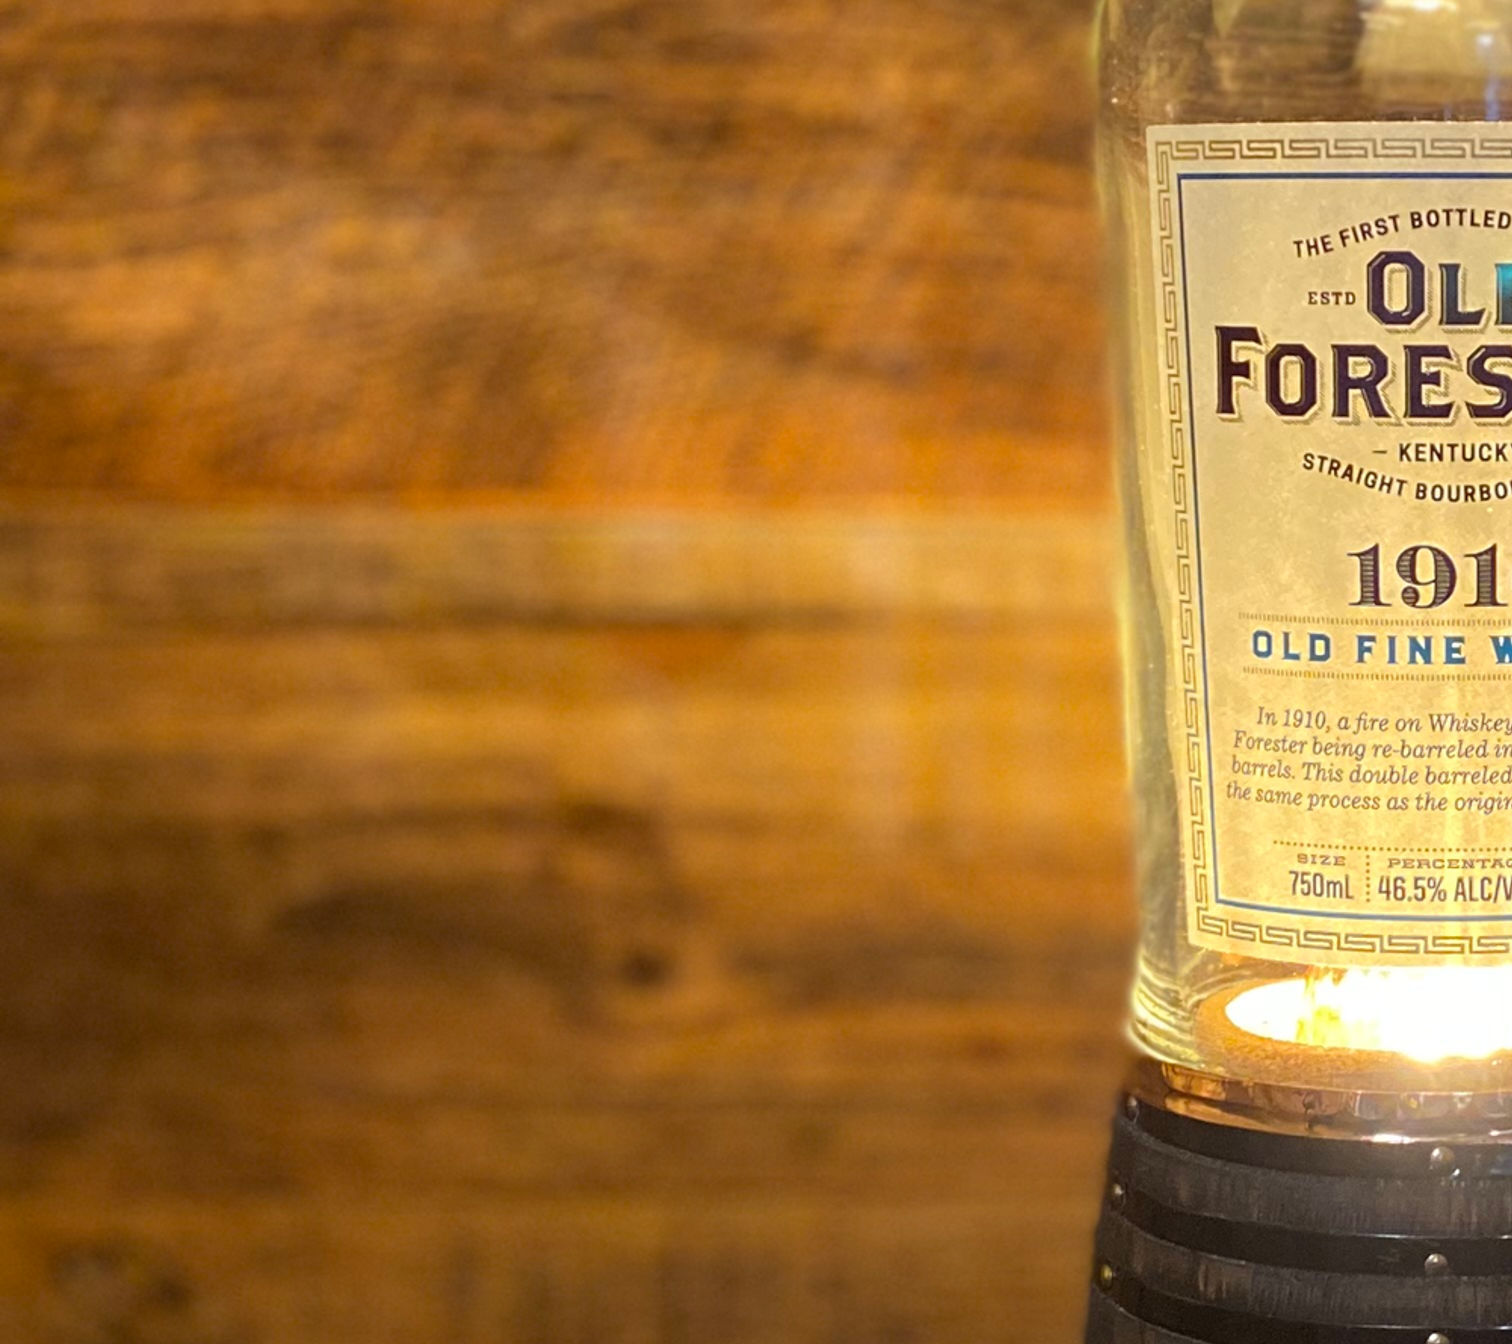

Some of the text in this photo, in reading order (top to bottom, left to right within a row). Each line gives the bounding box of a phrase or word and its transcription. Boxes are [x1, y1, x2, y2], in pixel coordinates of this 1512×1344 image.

[1293, 234, 1334, 258] THE
[1338, 214, 1400, 248] FIRST
[1409, 208, 1512, 230] BOTTLED
[1307, 291, 1357, 306] ESTD
[1302, 452, 1408, 497] STRAIGHT
[1252, 629, 1331, 662] OLD
[1355, 633, 1467, 665] FINE
[1256, 706, 1279, 726] In
[1283, 709, 1332, 734] 1910,
[1337, 716, 1350, 731] a
[1353, 712, 1390, 735] fire
[1395, 718, 1422, 733] on
[1233, 730, 1308, 755] Forester
[1312, 736, 1367, 762] being
[1371, 739, 1489, 760] re-barreled
[1231, 754, 1296, 781] barrels.
[1301, 761, 1344, 783] This
[1348, 763, 1419, 785] double
[1226, 780, 1252, 801] the
[1255, 787, 1302, 806] same
[1306, 792, 1381, 812] process
[1386, 796, 1410, 811] as
[1415, 792, 1449, 812] the
[1296, 853, 1347, 867] SIZE
[1288, 870, 1355, 900] 750mL
[1377, 875, 1448, 903] 46.5%
